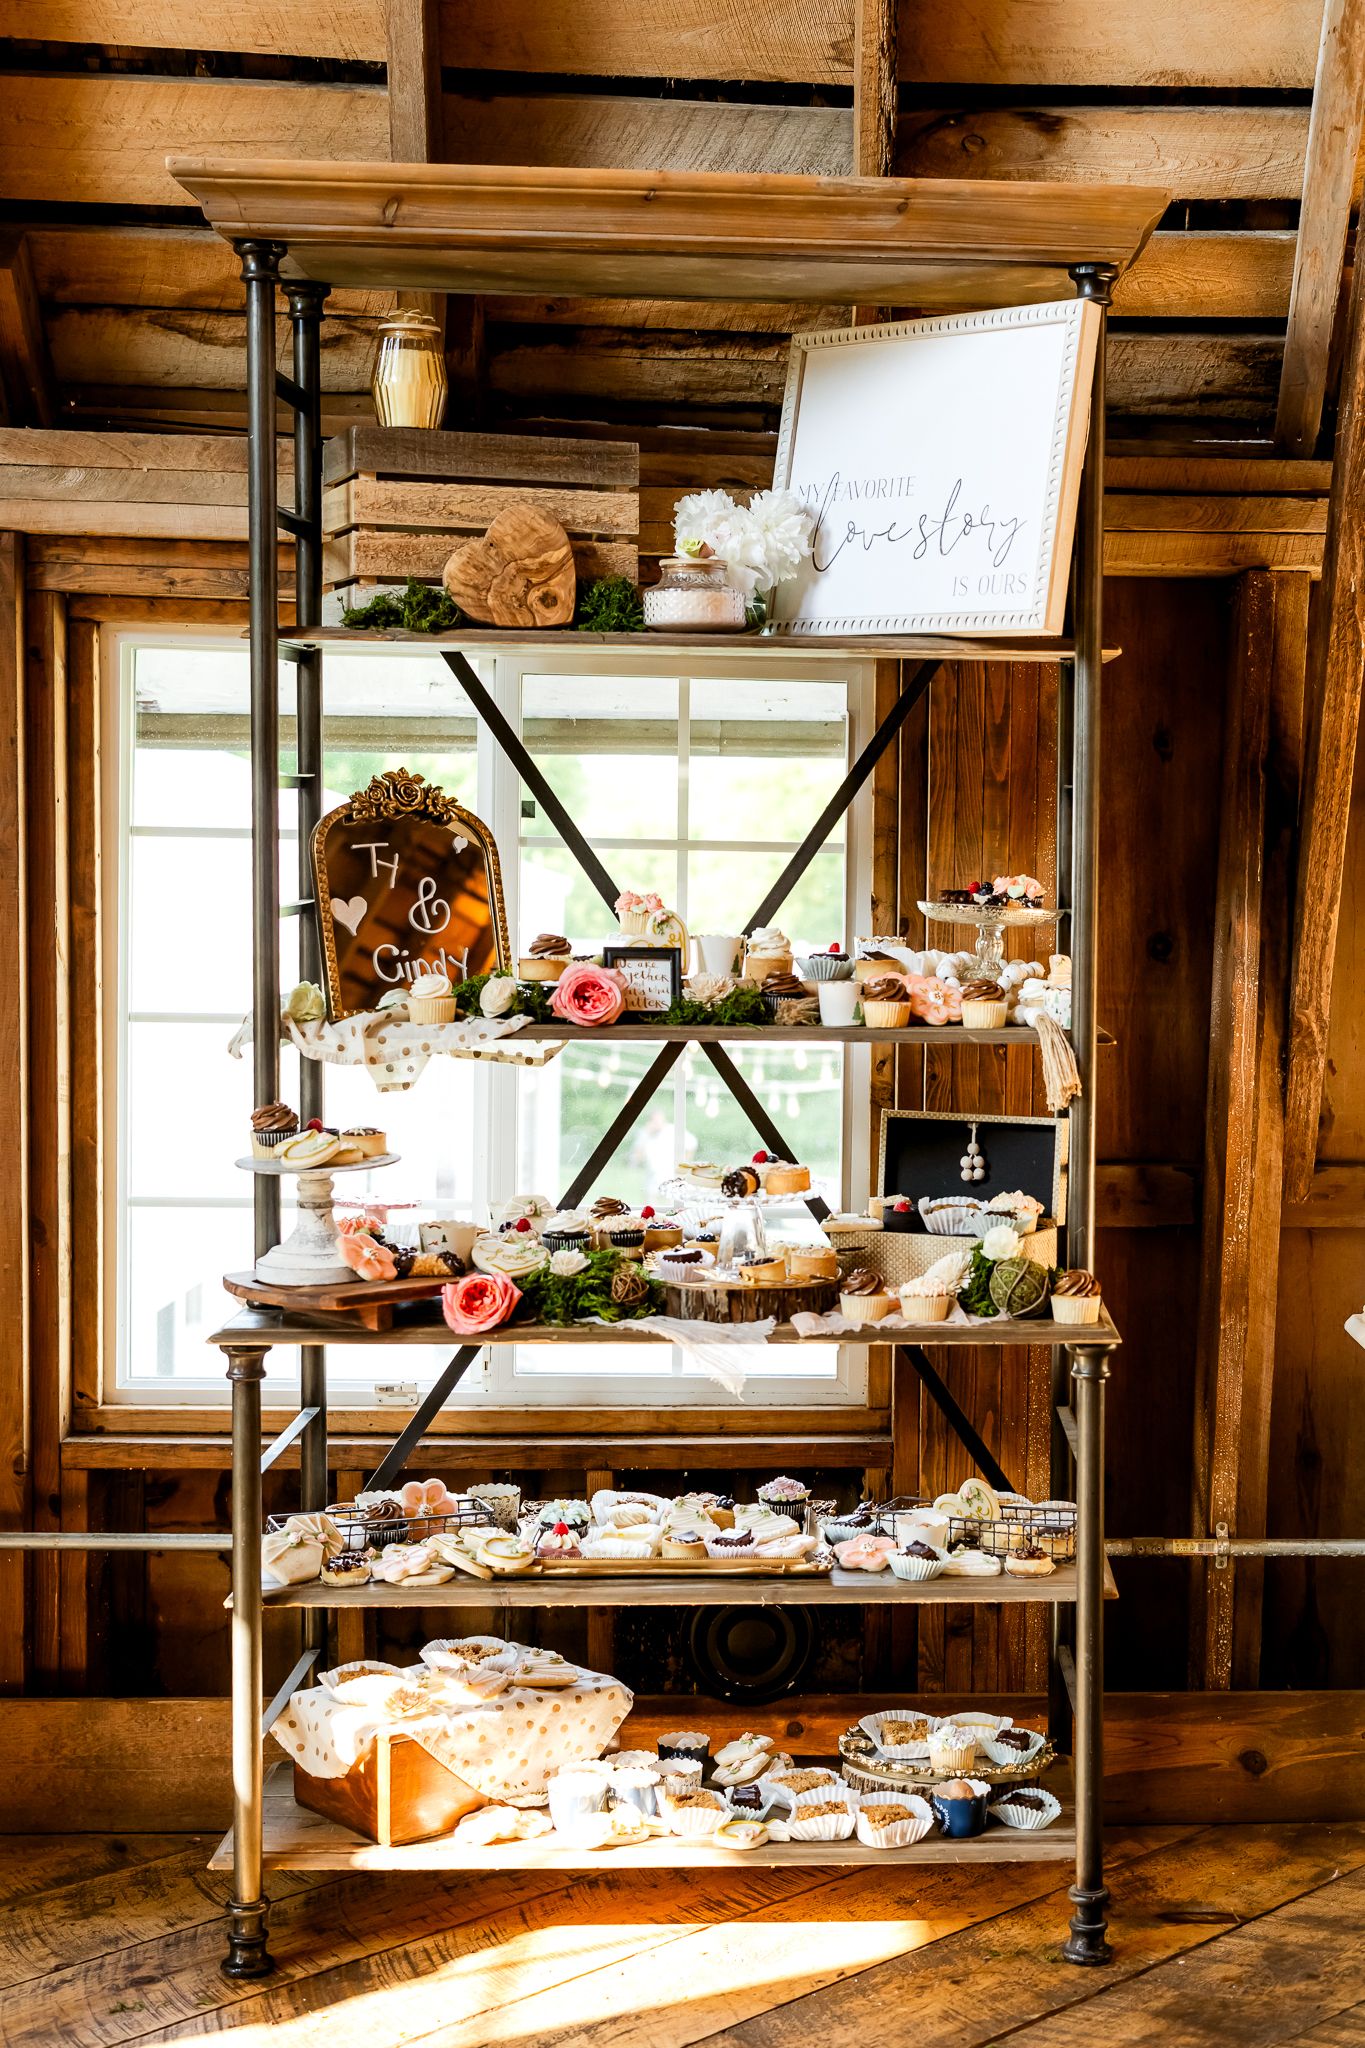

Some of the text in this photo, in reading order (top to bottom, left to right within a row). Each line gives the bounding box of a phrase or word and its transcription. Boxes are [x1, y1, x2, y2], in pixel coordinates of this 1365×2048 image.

[799, 476, 916, 503] MY FAVORITE
[952, 573, 1028, 597] IS OURS
[408, 876, 451, 934] &
